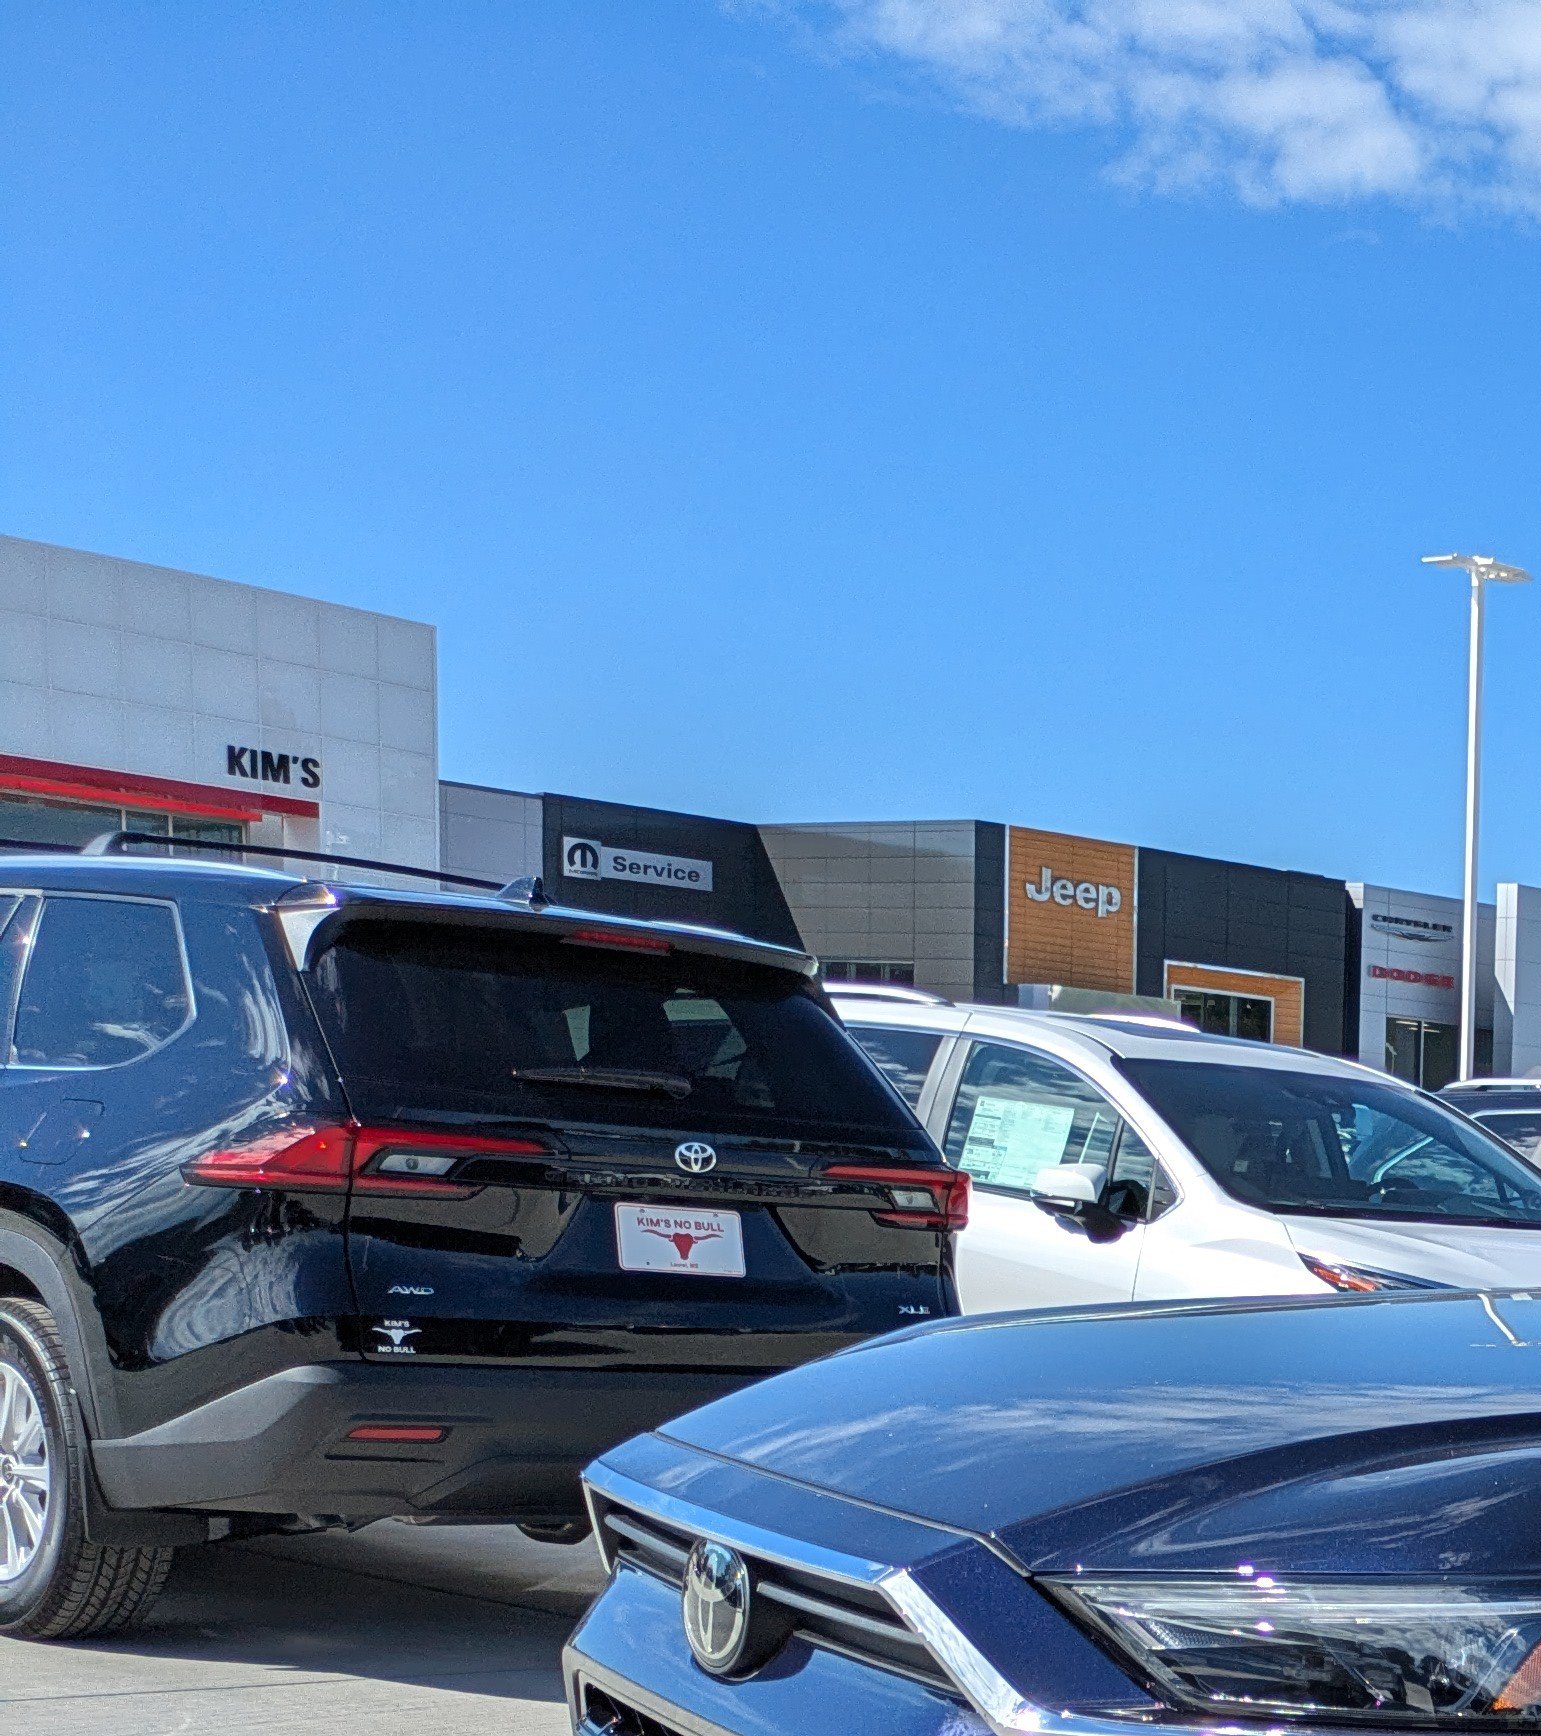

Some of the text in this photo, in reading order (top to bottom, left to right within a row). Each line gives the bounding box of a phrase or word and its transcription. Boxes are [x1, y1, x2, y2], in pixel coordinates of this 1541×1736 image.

[227, 745, 321, 789] KIM'S
[612, 855, 701, 883] Service
[1025, 866, 1122, 918] Jeep
[1371, 965, 1455, 990] DODGE
[636, 1216, 725, 1233] KIM'S NO BULL
[387, 1285, 435, 1295] AWD
[897, 1304, 931, 1315] XLE
[377, 1345, 392, 1353] NO
